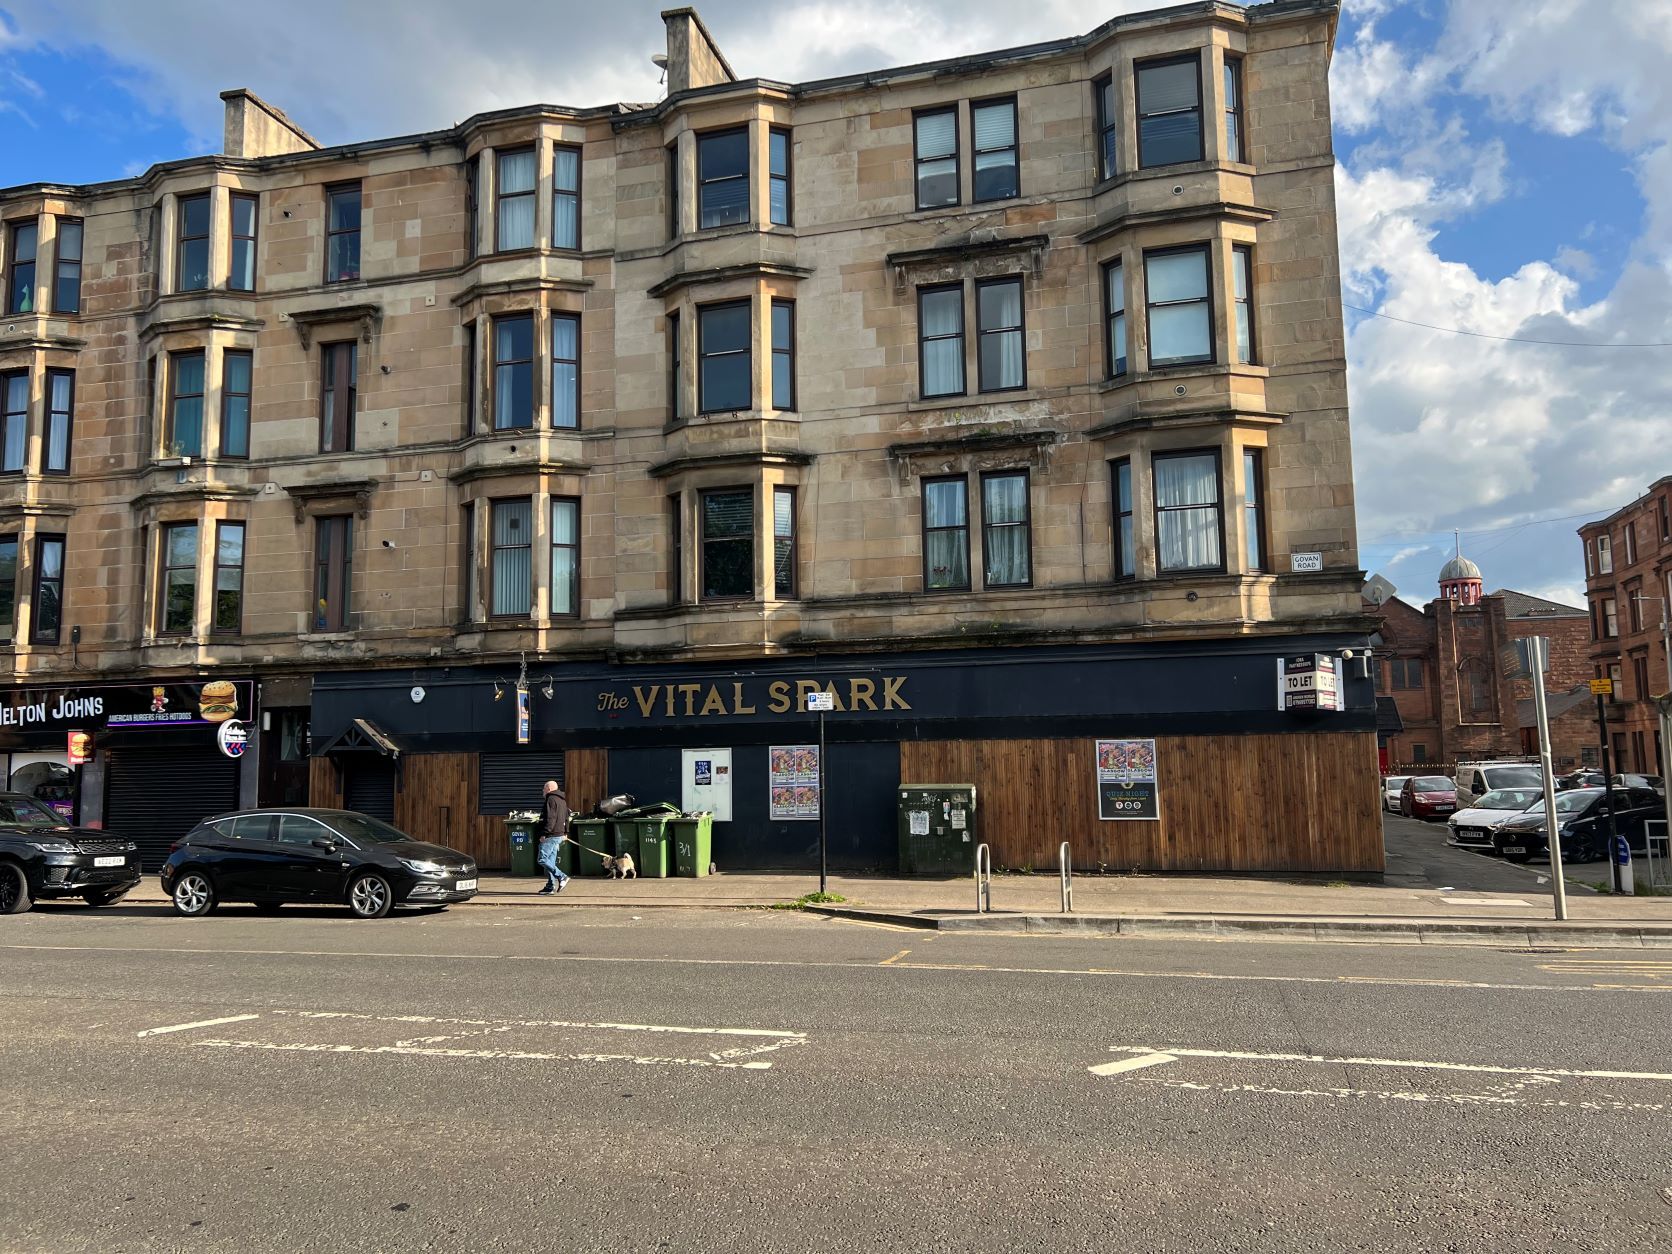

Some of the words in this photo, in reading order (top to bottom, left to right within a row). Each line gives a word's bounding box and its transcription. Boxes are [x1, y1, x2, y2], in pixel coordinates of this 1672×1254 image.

[1288, 677, 1298, 689] TO
[1300, 675, 1313, 687] LET
[52, 695, 103, 719] JOHNS
[597, 692, 630, 711] The
[632, 682, 756, 718] VITAL
[768, 677, 912, 714] SPARK
[108, 714, 133, 722] AMERICAN
[133, 713, 155, 722] BURGERS
[155, 713, 169, 721] FRIES
[169, 712, 192, 720] HOTDOGS
